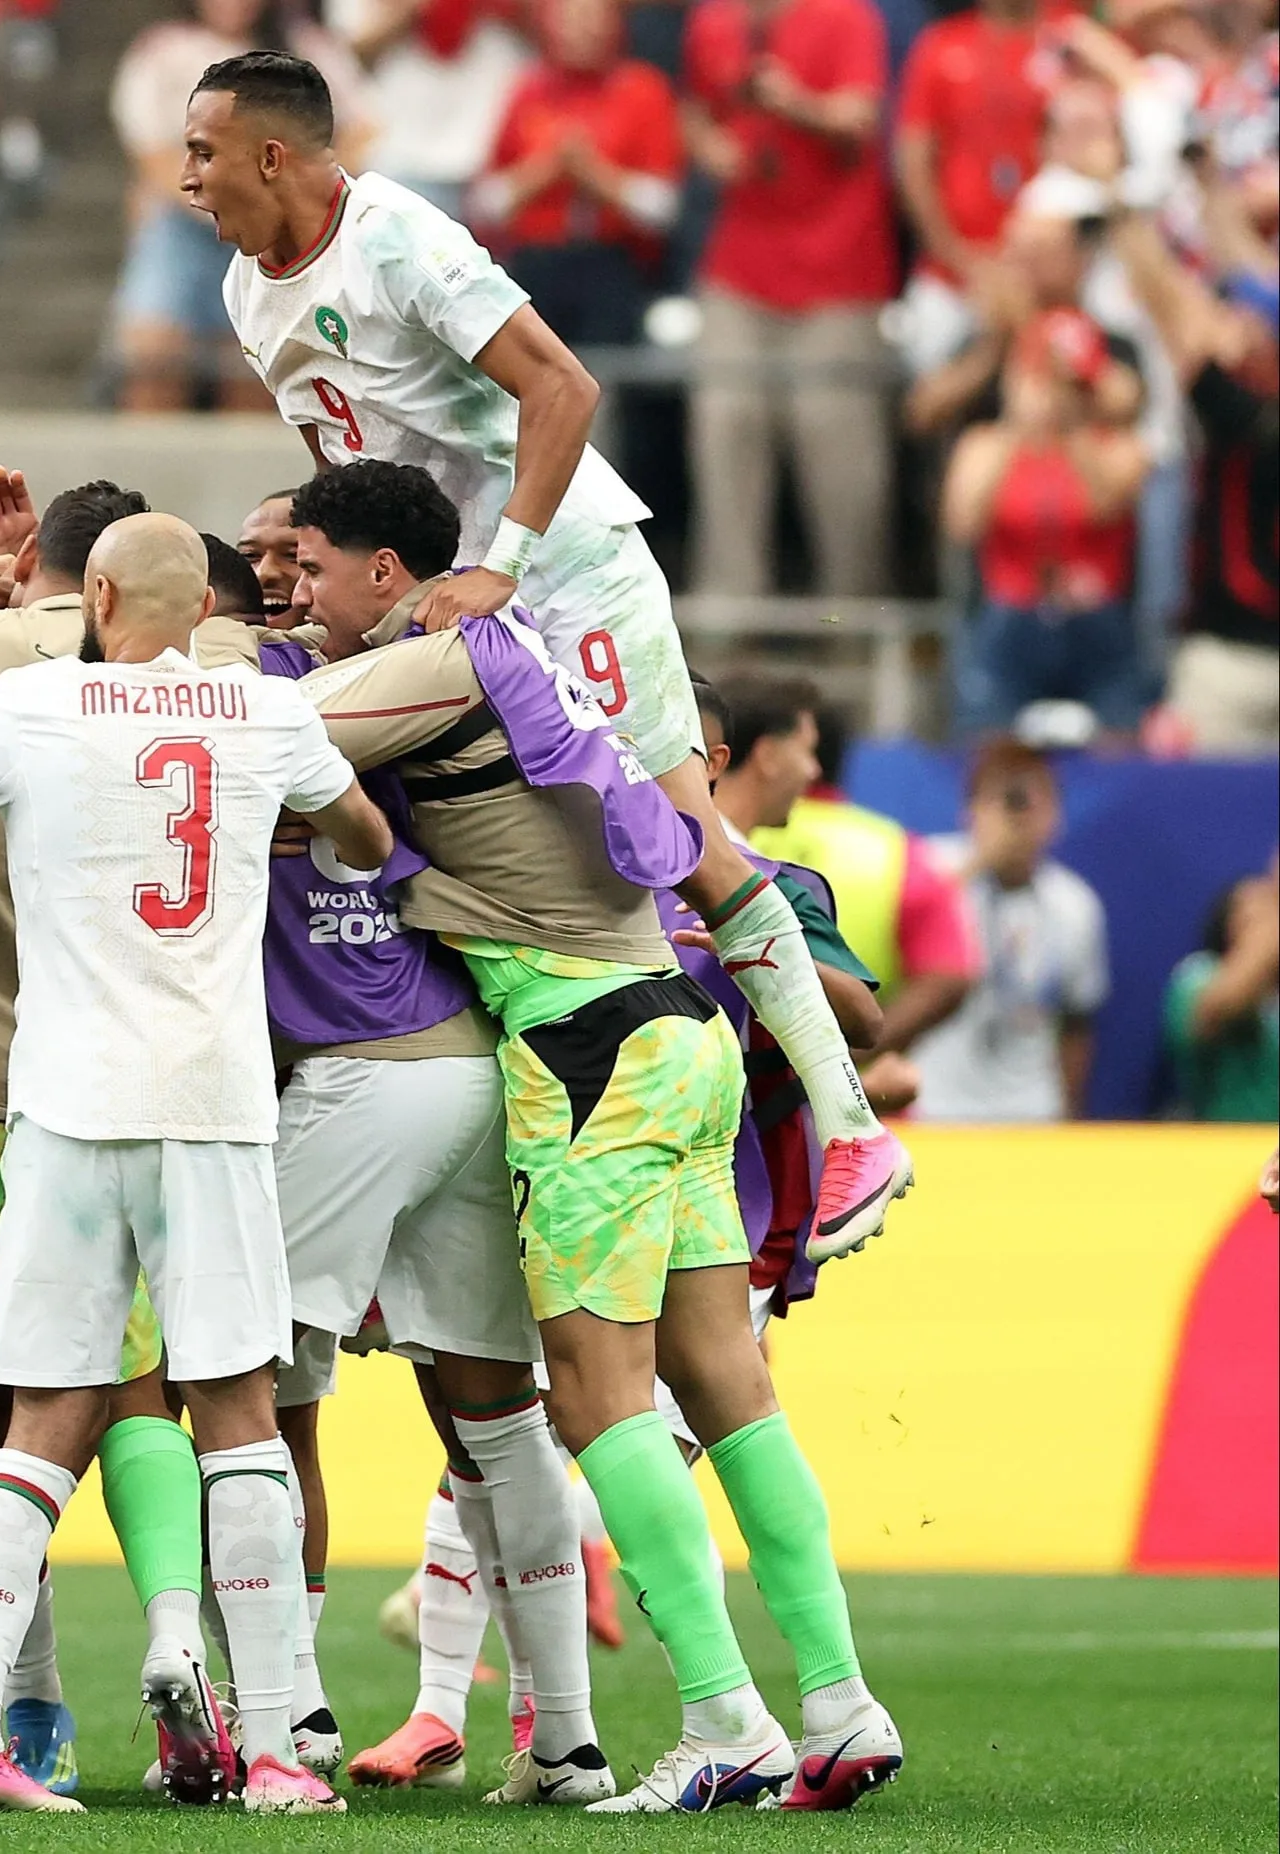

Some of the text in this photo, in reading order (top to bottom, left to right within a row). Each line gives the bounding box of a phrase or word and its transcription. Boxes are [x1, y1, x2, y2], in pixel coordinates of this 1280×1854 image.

[311, 377, 363, 451] 9
[81, 681, 247, 721] MAZRAOUI
[579, 629, 628, 717] 9
[133, 736, 220, 937] 3
